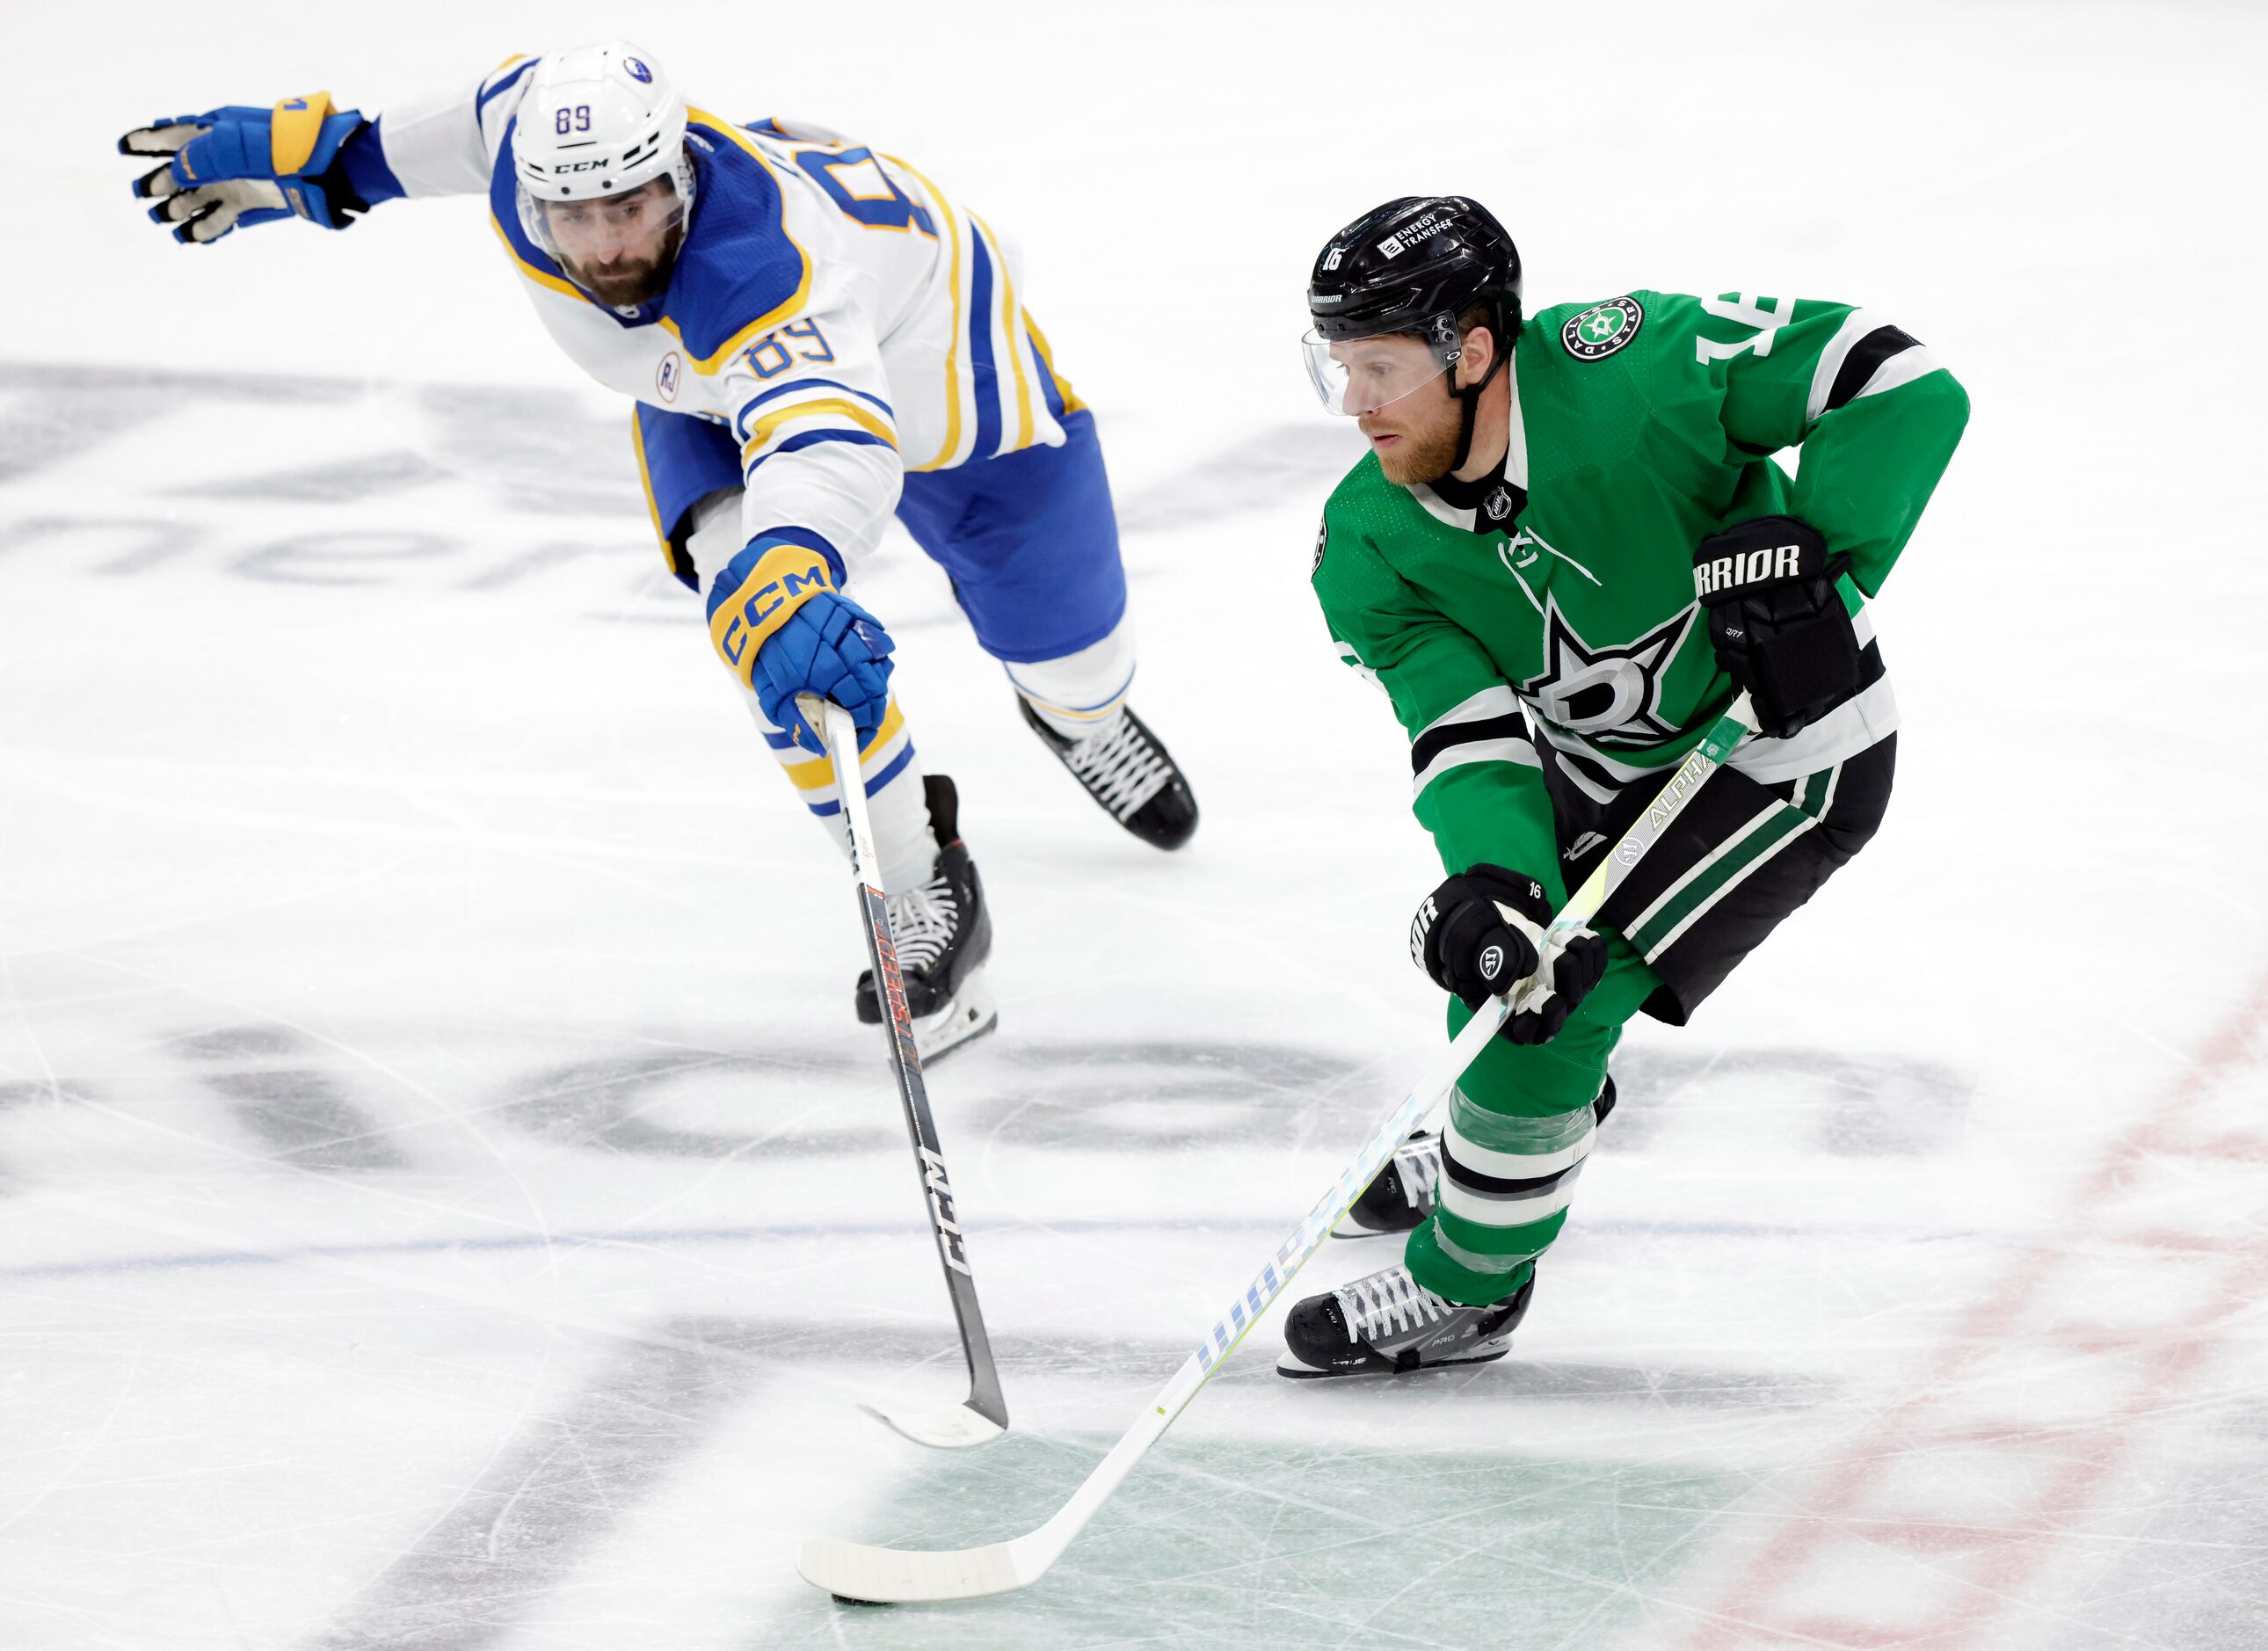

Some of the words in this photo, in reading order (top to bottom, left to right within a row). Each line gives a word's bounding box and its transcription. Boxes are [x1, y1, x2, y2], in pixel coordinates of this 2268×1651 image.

[556, 105, 591, 135] 89
[555, 158, 610, 175] CCM
[1398, 213, 1437, 241] ENERGY
[1403, 218, 1454, 249] TRANSFER
[1322, 247, 1350, 271] 16
[1311, 295, 1342, 304] WARRIOR
[1611, 300, 1637, 345] STARS
[741, 316, 837, 382] 89
[660, 360, 678, 393] RJ
[1693, 544, 1800, 598] RRIOR
[723, 565, 828, 666] CCM
[1529, 881, 1542, 899] 16
[918, 1146, 971, 1276] CCM
[1195, 1093, 1424, 1378] WARRIOR
[1432, 1335, 1455, 1347] PRO
